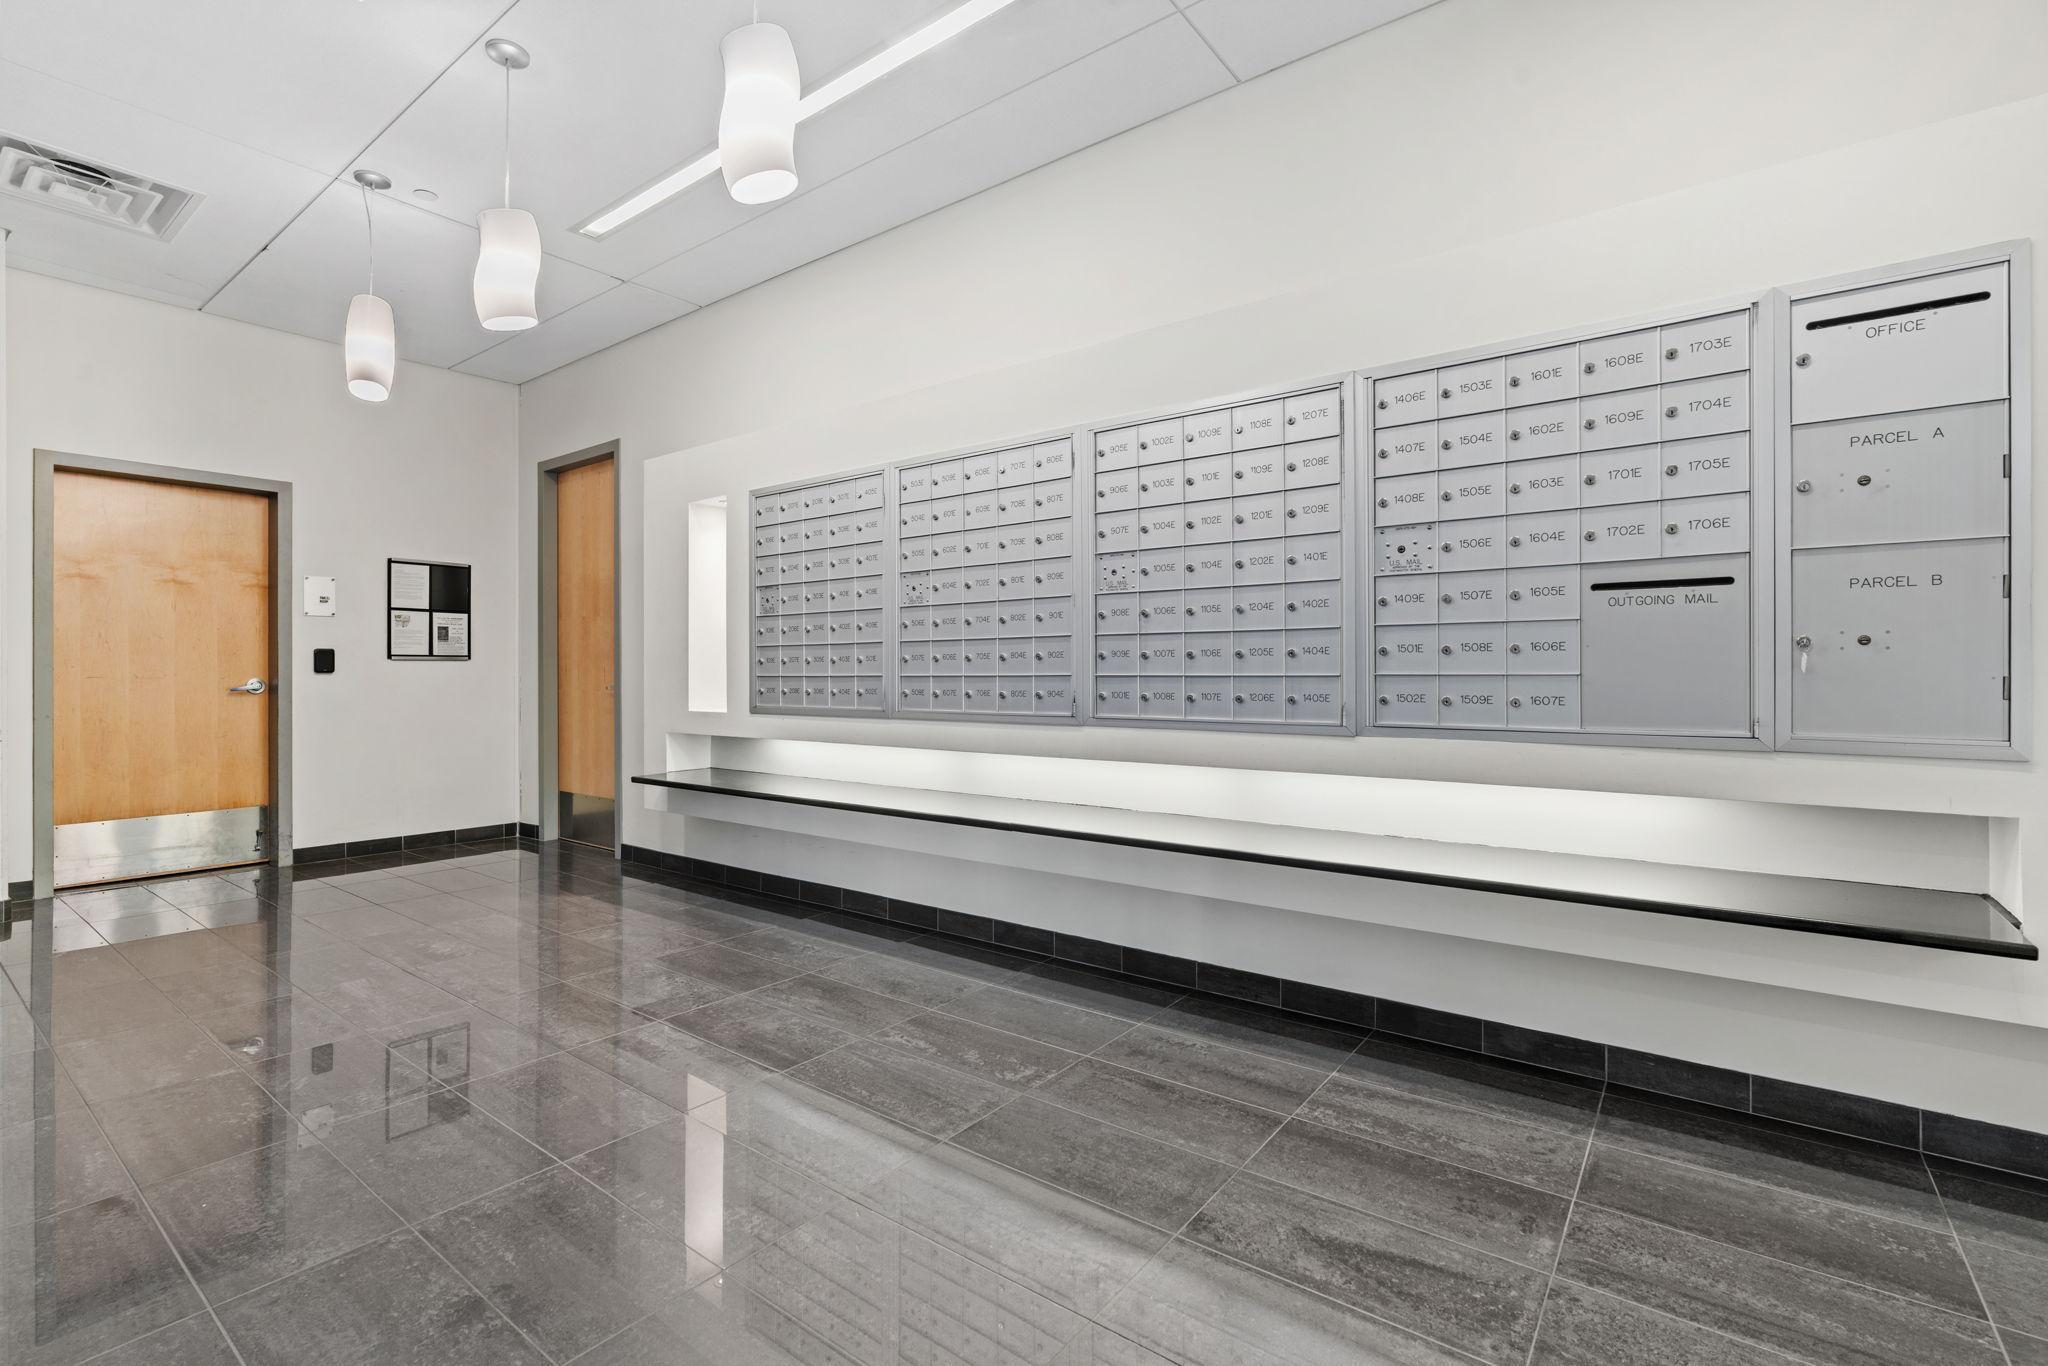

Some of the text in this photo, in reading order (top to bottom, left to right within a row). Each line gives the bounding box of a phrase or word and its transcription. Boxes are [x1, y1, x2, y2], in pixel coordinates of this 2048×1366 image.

[1866, 319, 1925, 338] OFFICE
[1690, 336, 1732, 352] 1703E
[1605, 353, 1643, 368] 1608E
[1531, 367, 1562, 381] 1601E
[1460, 380, 1492, 393] 1503E
[1395, 391, 1426, 404] 1406E
[1689, 397, 1732, 412] 1704E
[1302, 408, 1328, 420] 1207E
[1605, 410, 1644, 424] 1609E
[1250, 418, 1272, 429] 1108E
[1529, 422, 1564, 435] 1602E
[1198, 427, 1222, 438] 1009E
[1851, 427, 1944, 447] PARCEL A
[1152, 436, 1174, 446] 1002E
[1460, 432, 1492, 445] 1504E
[1110, 443, 1128, 453] 905E
[1395, 442, 1425, 454] 1407E
[1303, 456, 1329, 467] 1208E
[1689, 457, 1730, 471] 1705E
[1251, 464, 1272, 473] 1109E
[1608, 467, 1641, 480] 1701E
[1202, 472, 1219, 480] 1101E
[1153, 478, 1175, 488] 1003E
[1529, 477, 1564, 489] 1603E
[1110, 485, 1128, 494] 906E
[1459, 485, 1491, 497] 1505E
[1394, 493, 1424, 504] 1408E
[1303, 504, 1329, 514] 1209E
[1251, 510, 1272, 520] 1201E
[1153, 521, 1175, 530] 1004E
[1201, 516, 1222, 525] 1102E
[1688, 517, 1730, 530] 1706E
[1111, 526, 1128, 535] 907E
[1607, 524, 1645, 536] 1702E
[1529, 531, 1565, 542] 1604E
[1459, 538, 1492, 548] 1506E
[1250, 556, 1274, 565] 1202E
[1304, 552, 1327, 560] 1401E
[1154, 563, 1176, 572] 1005E
[1201, 560, 1222, 569] 1104E
[1850, 574, 1942, 588] PARCEL B
[1460, 590, 1492, 600] 1507E
[1530, 586, 1565, 597] 1605E
[1395, 593, 1424, 603] 1409E
[1608, 593, 1718, 607] OUTGOING MAIL
[1248, 602, 1274, 611] 1204E
[1302, 599, 1330, 608] 1402E
[1111, 608, 1129, 616] 908E
[1154, 606, 1176, 615] 1006E
[1201, 605, 1222, 613] 1105E
[1302, 646, 1330, 655] 1404E
[1397, 644, 1423, 653] 1501E
[1461, 643, 1493, 652] 1508E
[1530, 641, 1566, 651] 1606E
[1201, 649, 1221, 657] 1106E
[1249, 648, 1274, 656] 1205E
[1112, 691, 1130, 699] 1001E
[1153, 692, 1175, 700] 1008E
[1201, 693, 1221, 701] 1107E
[1250, 693, 1275, 702] 1206E
[1303, 694, 1330, 703] 1405E
[1397, 694, 1426, 703] 1502E
[1461, 695, 1493, 704] 1509E
[1531, 696, 1565, 706] 1607E
